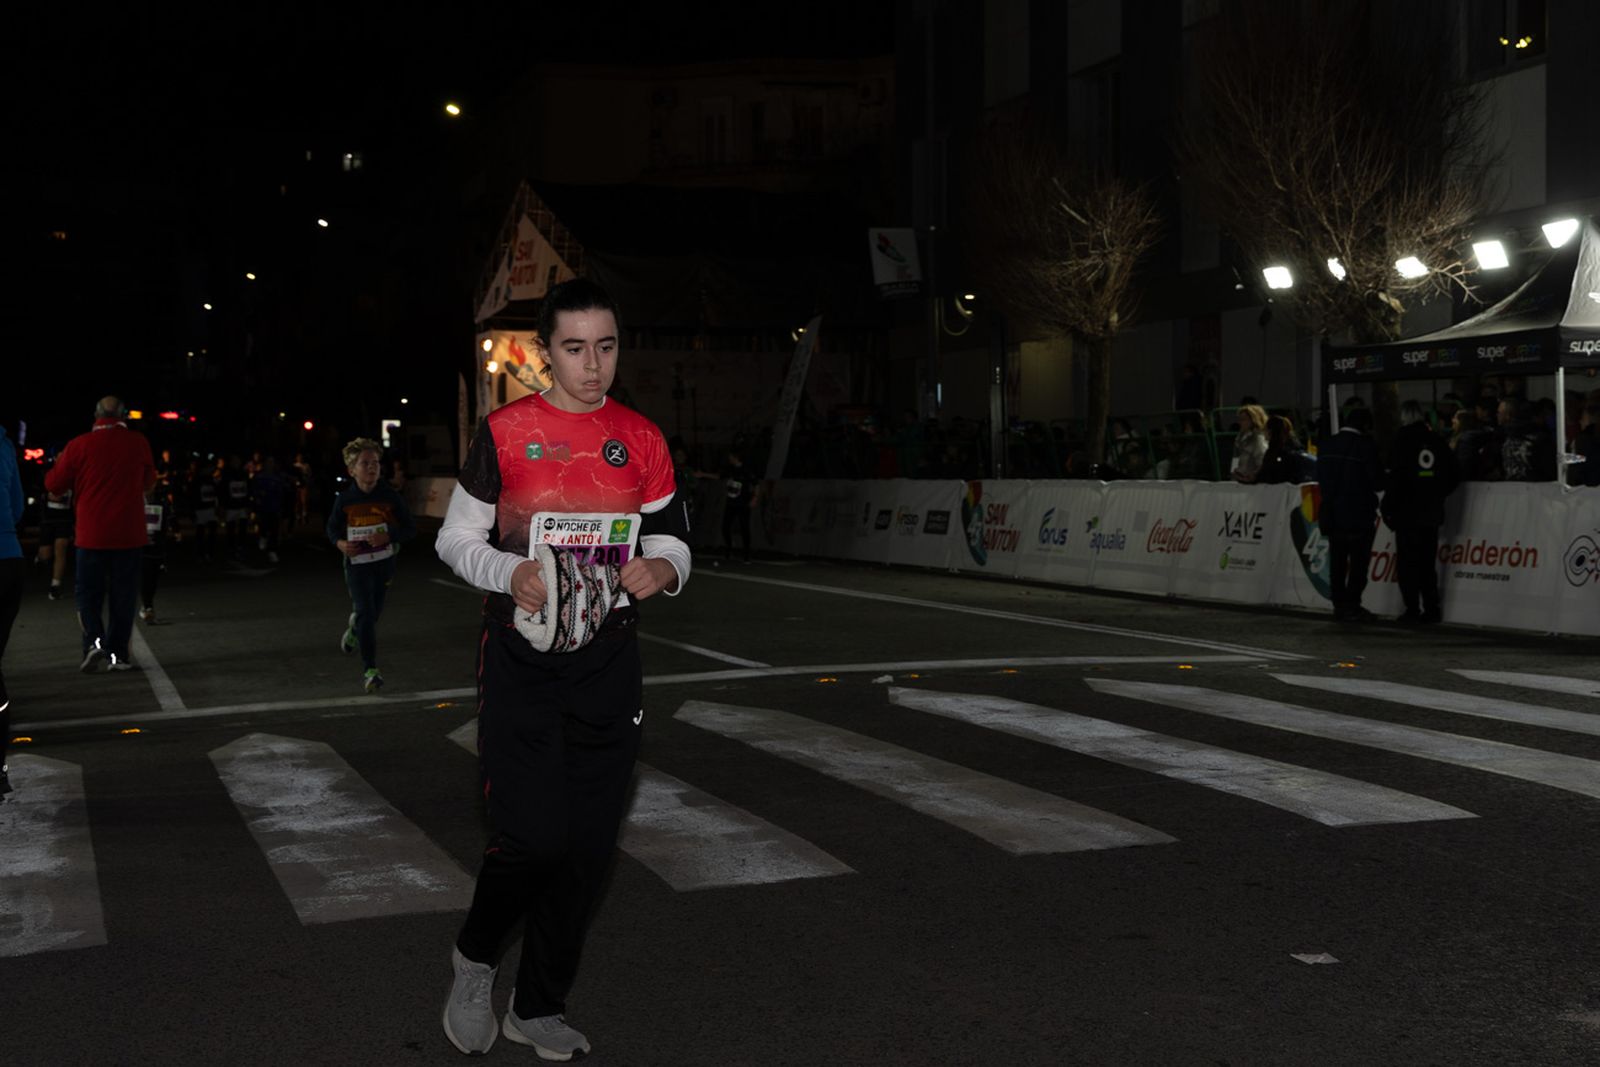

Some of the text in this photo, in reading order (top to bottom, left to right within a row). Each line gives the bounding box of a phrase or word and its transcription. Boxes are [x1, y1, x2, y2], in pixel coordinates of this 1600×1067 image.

[556, 522, 603, 532] NOCHE DE
[984, 503, 1010, 526] SAN
[1218, 511, 1268, 540] XAVE
[566, 532, 603, 545] ANTÓN
[1089, 528, 1126, 555] aqualia
[1438, 539, 1538, 569] calderón
